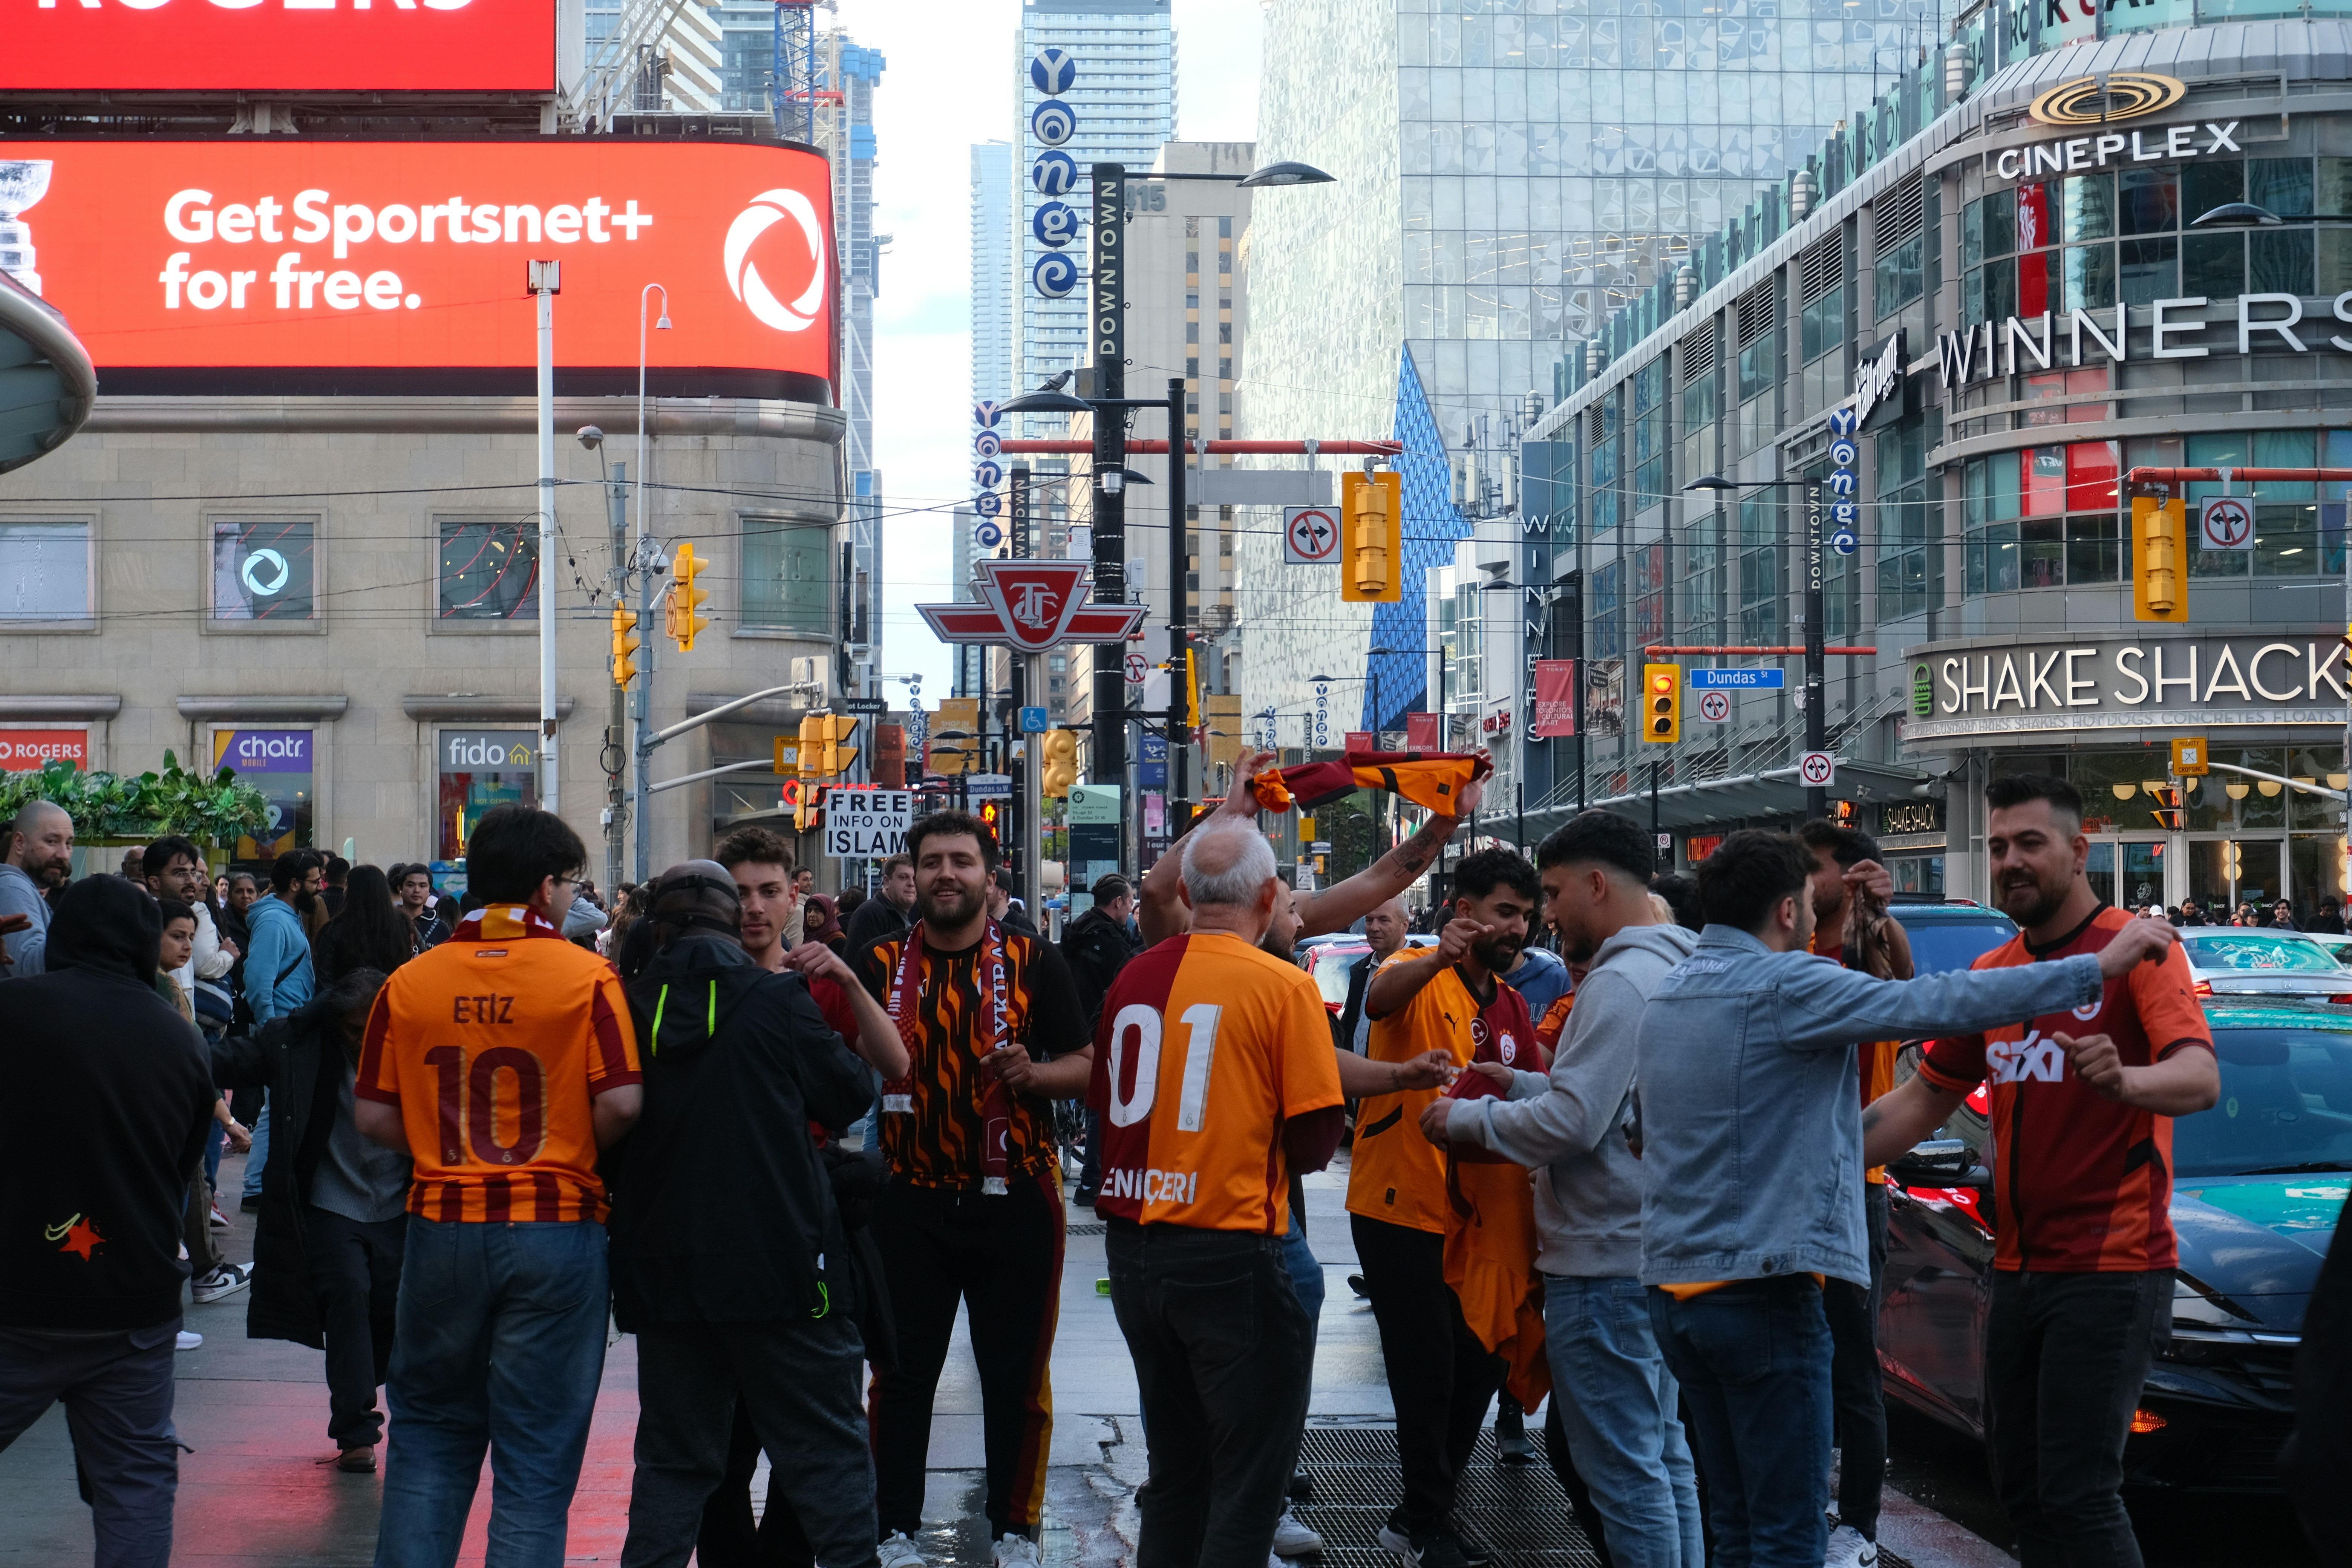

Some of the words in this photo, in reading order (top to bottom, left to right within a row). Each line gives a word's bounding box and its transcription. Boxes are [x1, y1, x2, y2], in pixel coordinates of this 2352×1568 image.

[1997, 121, 2241, 180] CINEPLEX
[164, 188, 283, 243] Get
[293, 188, 652, 259] Sportsnet+
[160, 252, 256, 310] for
[270, 252, 421, 310] free.
[1100, 181, 1116, 355] DOWNTOWN
[1856, 332, 1897, 431] ballroom
[1829, 408, 1857, 556] Yonge
[1015, 479, 1026, 558] WNTOWN
[1810, 487, 1821, 590] DOWNTOWN
[1707, 671, 1756, 684] Dundas
[1942, 649, 2099, 714] SHAKE
[2114, 643, 2347, 704] SHACK
[1316, 684, 1328, 745] Yonge
[1979, 718, 2009, 732] FRIES
[2015, 715, 2066, 730] SHAKES
[2073, 715, 2103, 728] HOT
[2108, 712, 2153, 726] DOGS
[2161, 710, 2265, 725] CONCRETES
[2274, 709, 2336, 723] FLOATS
[15, 744, 82, 758] ROGERS
[239, 736, 303, 757] chatr
[242, 759, 266, 767] MOBILE
[449, 737, 505, 765] fido
[831, 794, 906, 812] FREE
[835, 815, 873, 827] INFO
[880, 816, 903, 828] ON
[1888, 806, 1911, 833] SHAKE
[1911, 803, 1936, 831] SHACK
[829, 831, 907, 854] ISLAM
[1687, 838, 1701, 861] LITTLE
[454, 993, 515, 1024] ETİZ
[1107, 1003, 1223, 1132] 01
[424, 1046, 547, 1166] 10
